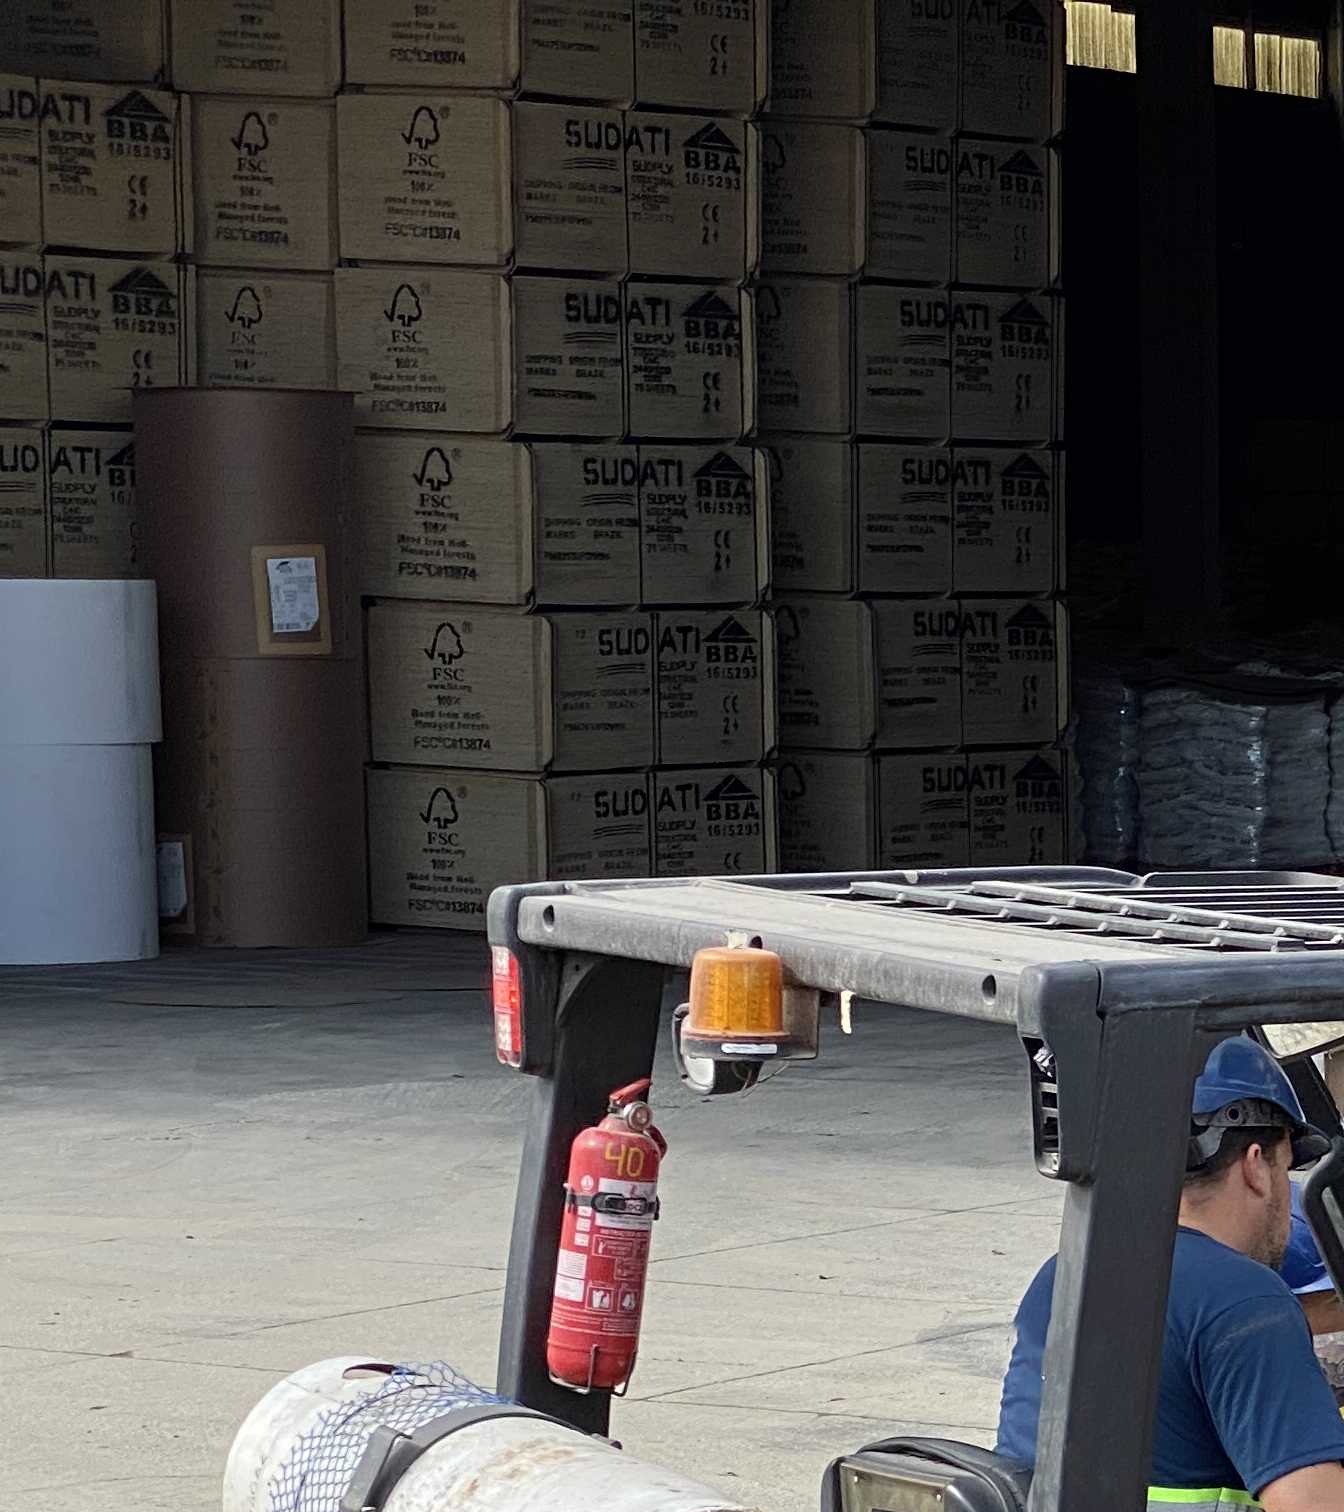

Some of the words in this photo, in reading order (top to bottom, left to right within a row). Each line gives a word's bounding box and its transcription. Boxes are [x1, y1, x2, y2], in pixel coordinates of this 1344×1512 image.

[1004, 23, 1048, 45] BBA
[0, 89, 90, 125] UDATI
[106, 118, 171, 144] BBA
[565, 119, 671, 156] SUDATI
[238, 157, 268, 174] FSC
[407, 152, 440, 168] FSC
[684, 150, 741, 174] BBA
[905, 146, 995, 180] SUDATI
[1000, 174, 1044, 196] BBA
[0, 265, 96, 300] UDATI
[112, 293, 176, 318] BBA
[564, 293, 671, 326] SUDATI
[900, 300, 989, 331] SUDATI
[391, 329, 422, 344] FSC
[684, 319, 739, 340] BBA
[1000, 324, 1048, 346] BBA
[0, 444, 101, 476] UDATI
[583, 457, 683, 487] SUDATI
[901, 458, 991, 486] SUDATI
[696, 478, 750, 499] BBA
[1001, 479, 1049, 498] BBA
[420, 493, 452, 509] FSC
[913, 611, 997, 637] SUDATI
[598, 625, 700, 656] SUDATI
[1007, 628, 1053, 646] BBA
[706, 645, 757, 664] BBA
[432, 666, 465, 682] FSC
[922, 764, 1006, 793] SUDATI
[1015, 781, 1060, 798] BBA
[594, 783, 700, 818] SUDATI
[706, 802, 759, 821] BBA
[427, 831, 459, 847] FSC
[605, 1141, 645, 1177] 40
